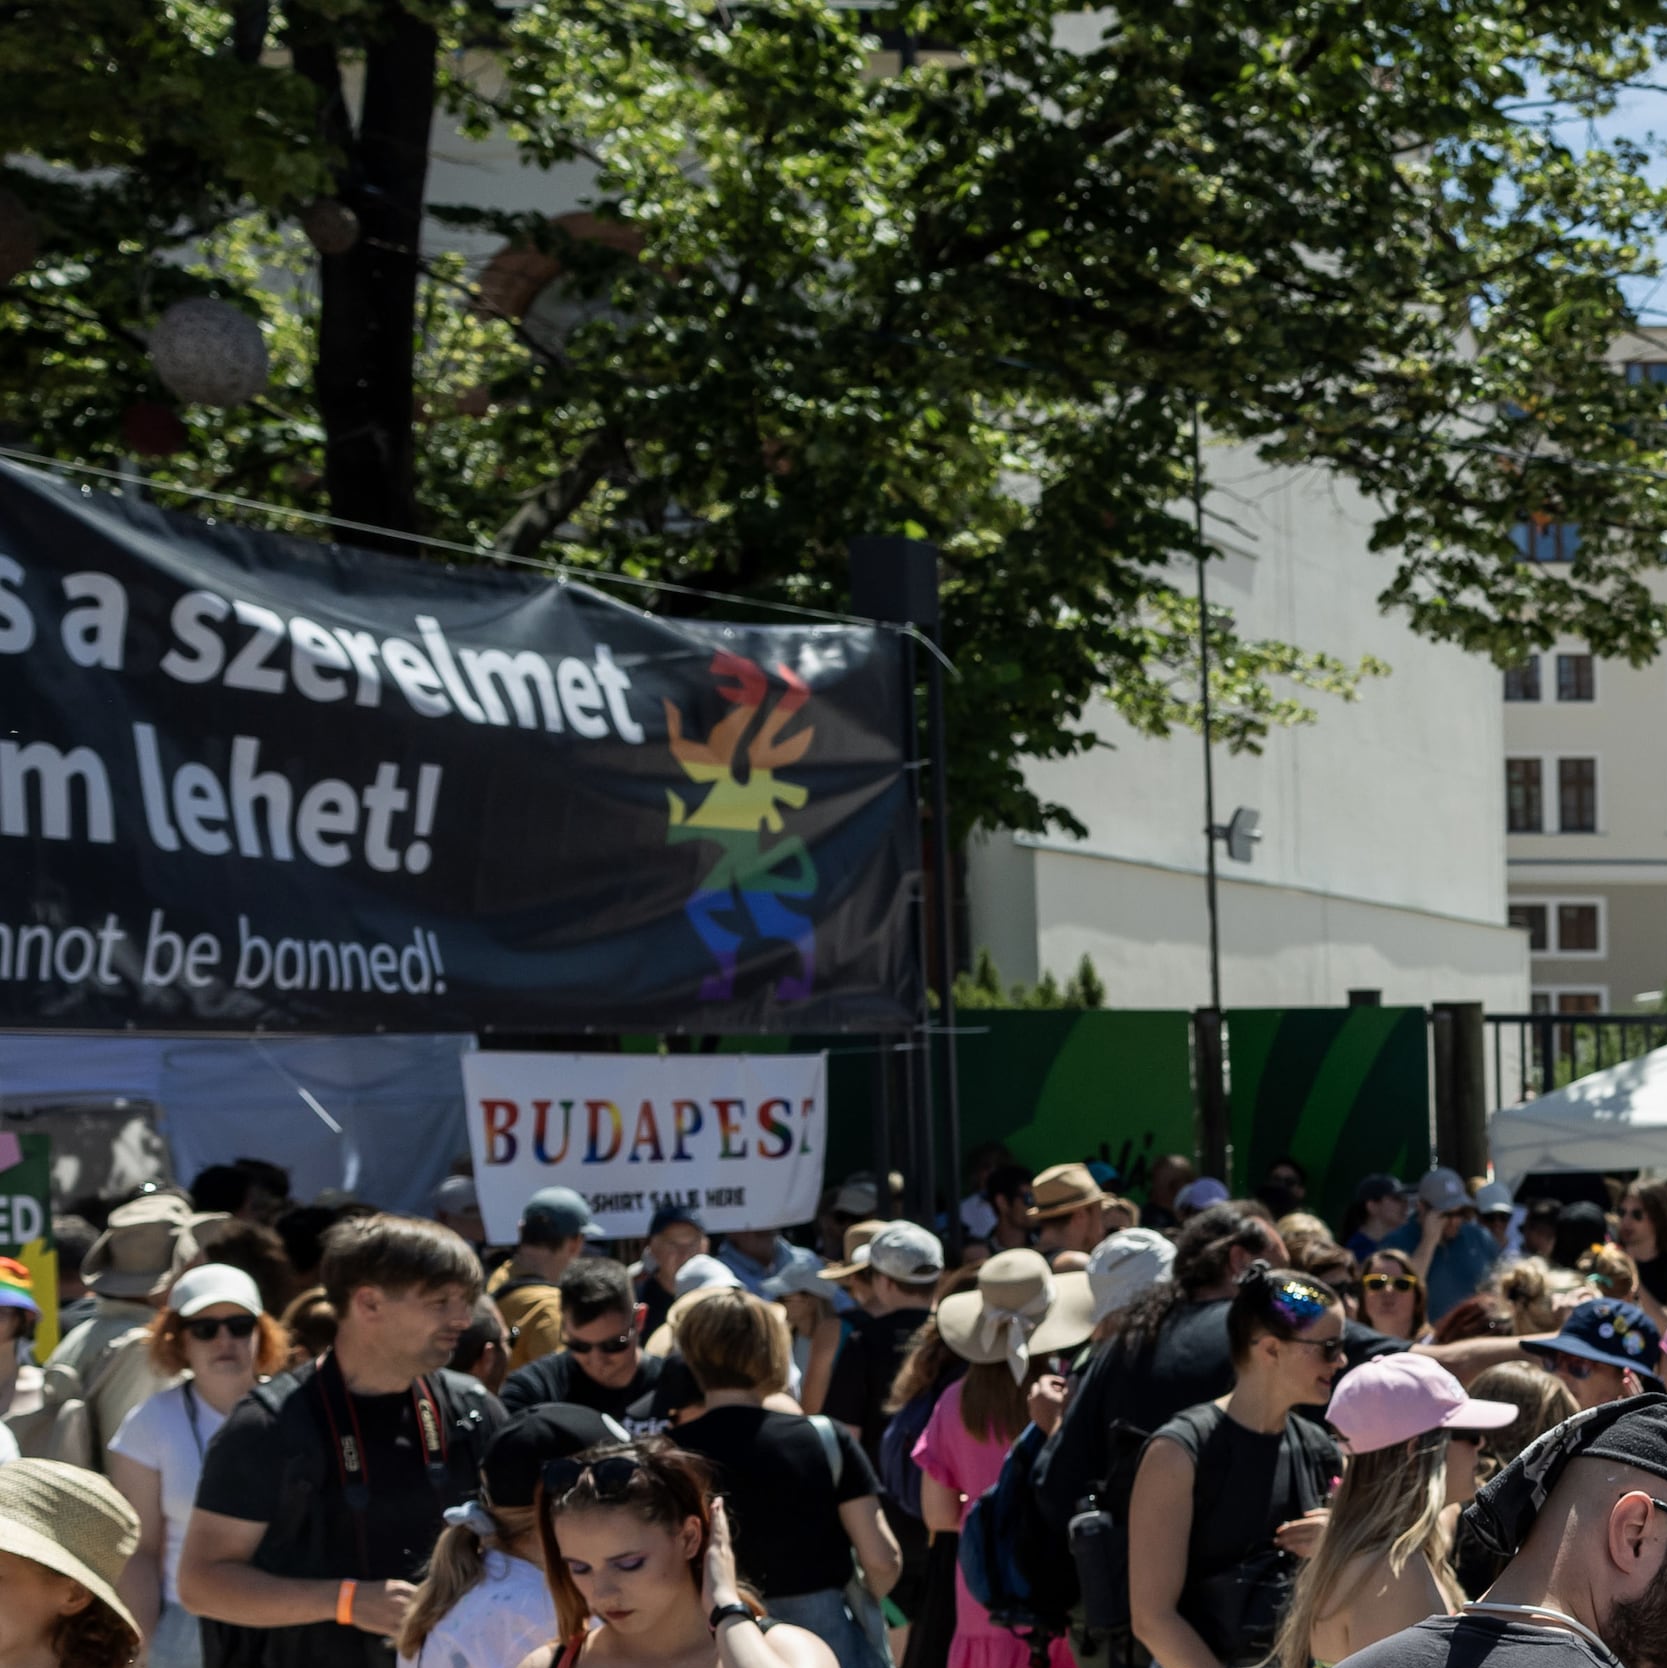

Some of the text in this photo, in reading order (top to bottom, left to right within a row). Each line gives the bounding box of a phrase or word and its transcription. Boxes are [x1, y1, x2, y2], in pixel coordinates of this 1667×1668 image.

[62, 571, 127, 672] a
[161, 591, 645, 744] szerelmet
[133, 722, 443, 875] lehet!
[143, 908, 222, 988] be
[235, 914, 448, 996] banned!
[583, 1191, 643, 1214] -SHIRT
[706, 1187, 746, 1207] HERE
